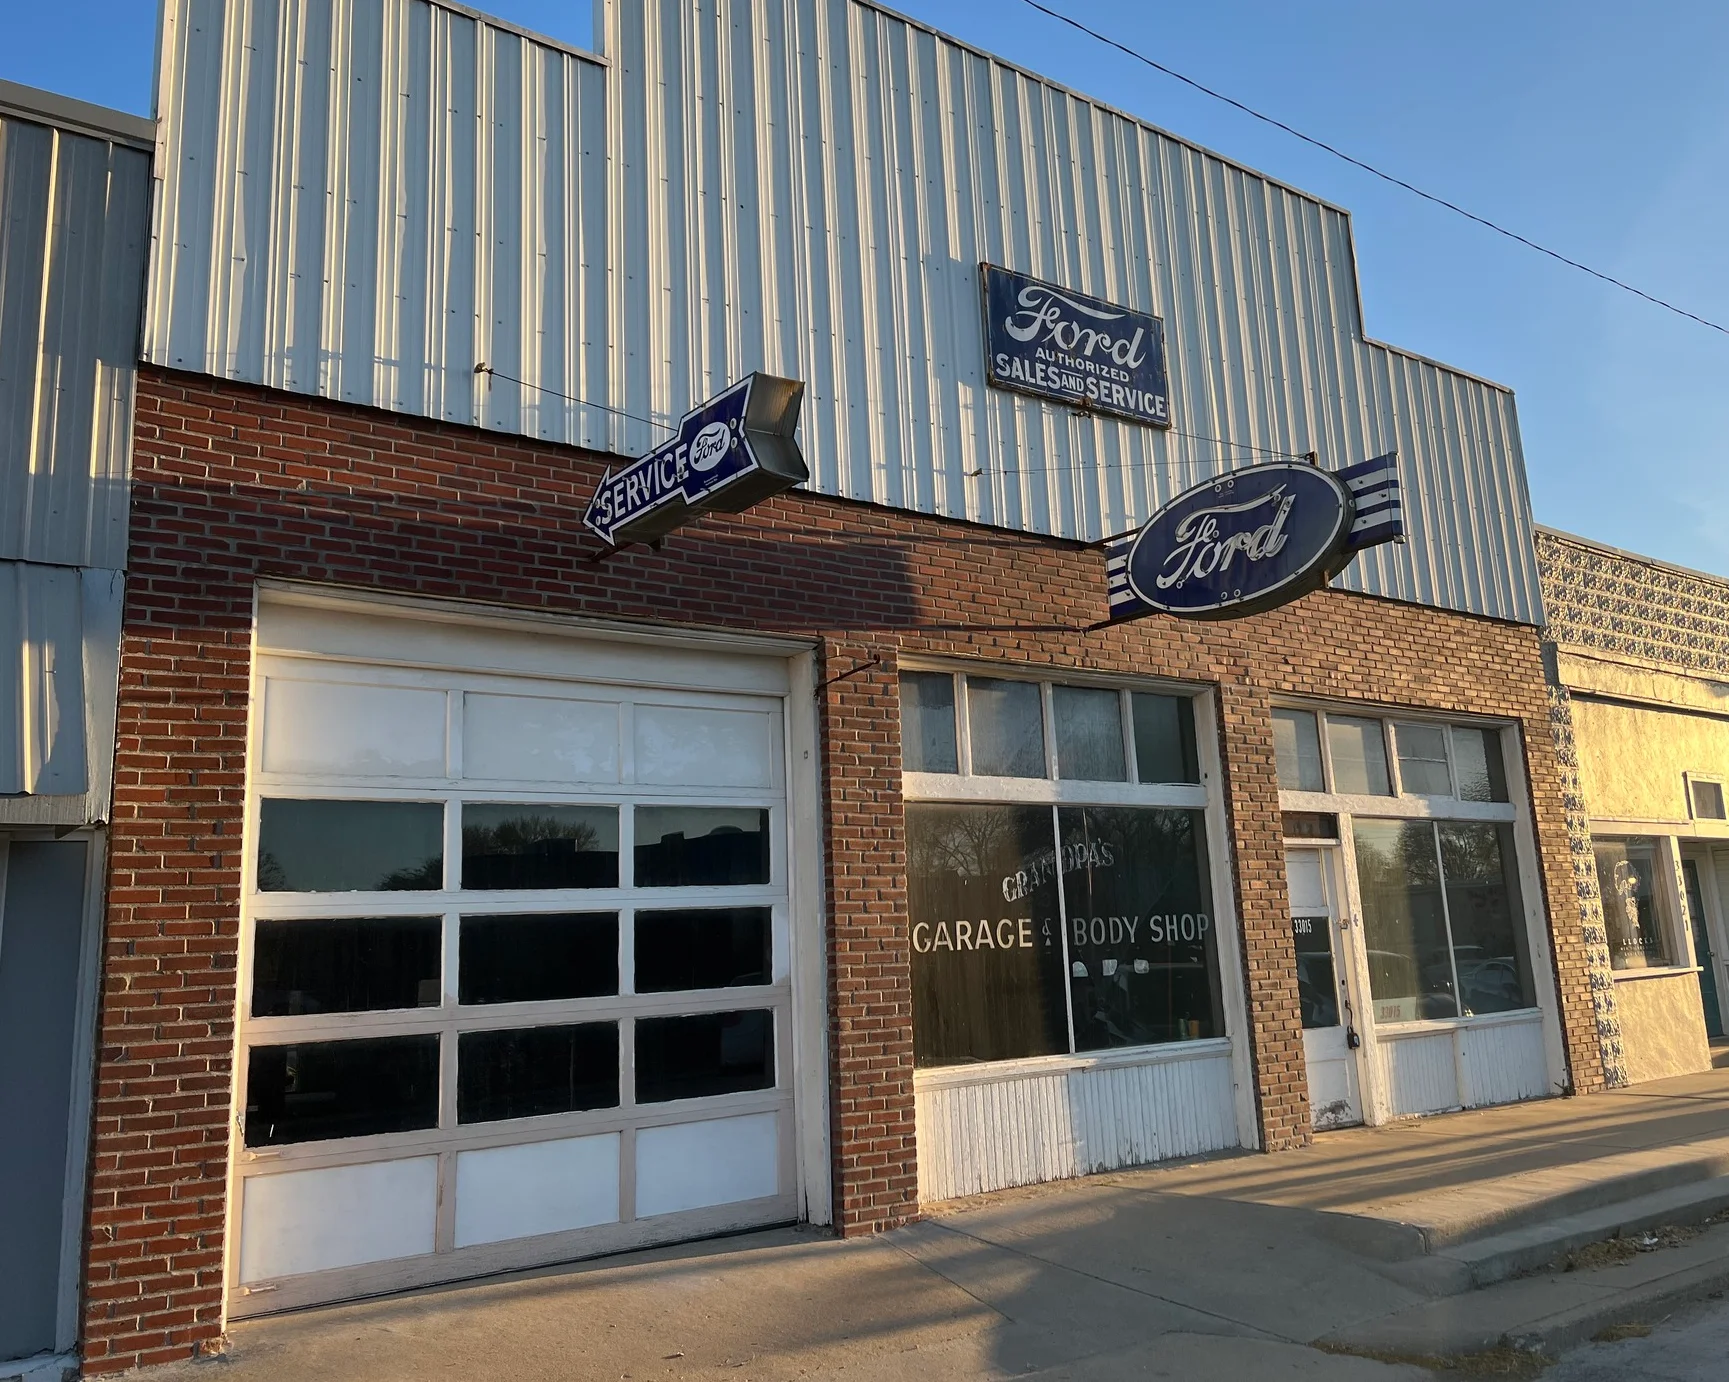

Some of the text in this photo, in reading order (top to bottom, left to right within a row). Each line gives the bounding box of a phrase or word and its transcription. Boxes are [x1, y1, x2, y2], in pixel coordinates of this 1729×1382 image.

[1005, 286, 1146, 368] Ford
[996, 353, 1167, 417] SALES AND SERVICE
[1035, 347, 1130, 382] AUTHORIZED
[601, 428, 726, 525] SERVICE Ford
[1156, 483, 1297, 590] Ford
[912, 918, 1033, 953] GARAGE
[1072, 915, 1139, 946] BODY
[1150, 913, 1209, 943] SHOP
[1294, 918, 1312, 933] 33015
